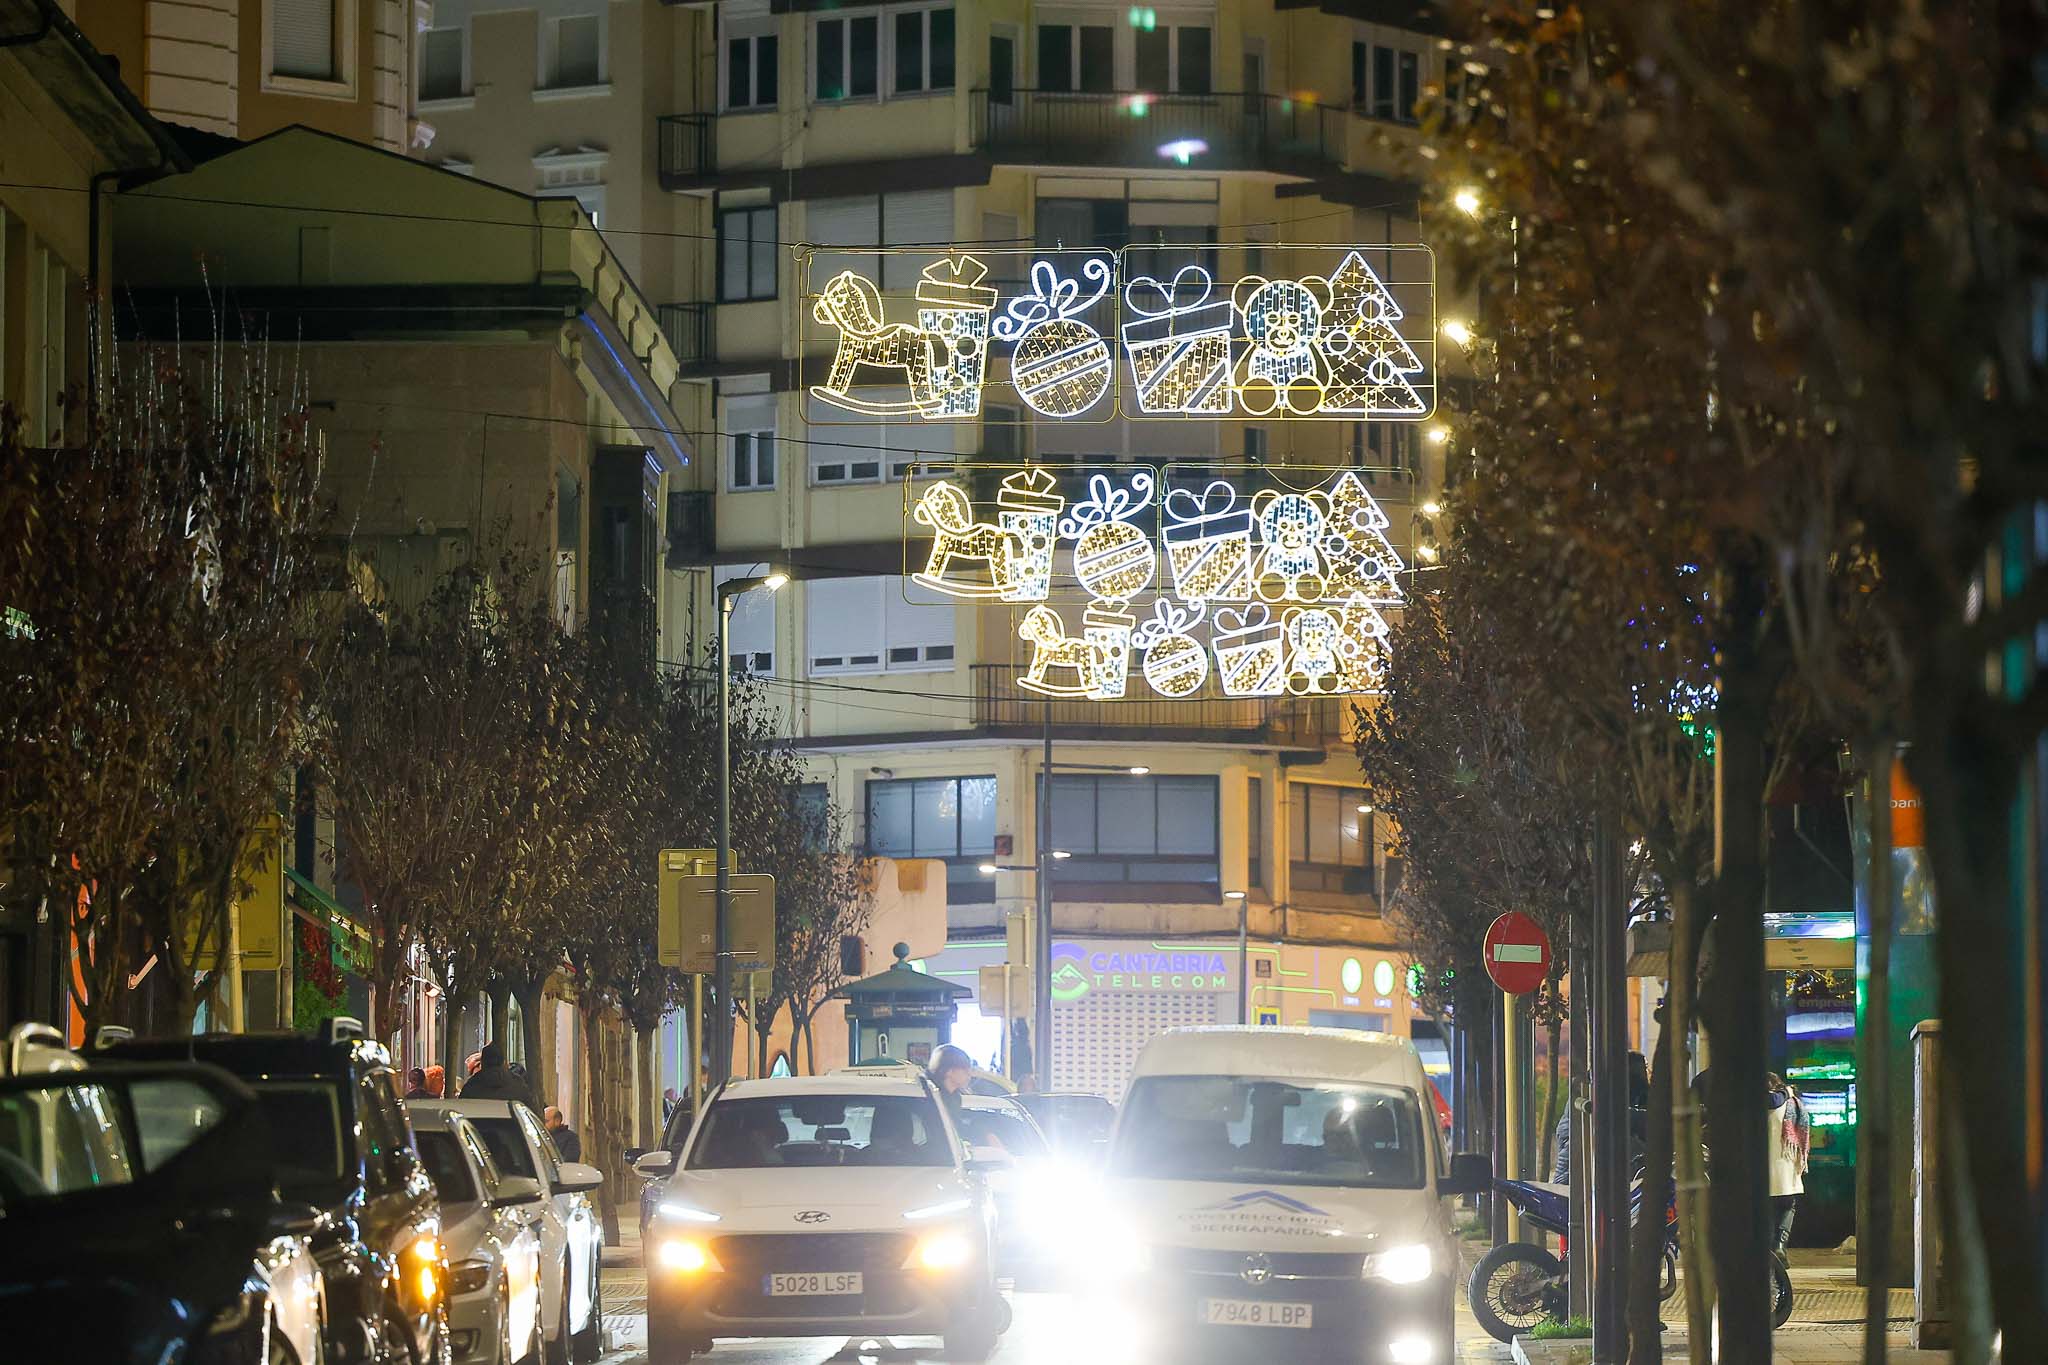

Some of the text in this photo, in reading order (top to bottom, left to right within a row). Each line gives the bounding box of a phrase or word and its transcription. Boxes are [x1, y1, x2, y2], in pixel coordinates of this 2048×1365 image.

[1089, 952, 1227, 974] CANTABRIA
[1093, 975, 1226, 987] TELECOM
[775, 1275, 857, 1292] 5028 LSF
[1212, 1303, 1306, 1324] 7948 LBP
